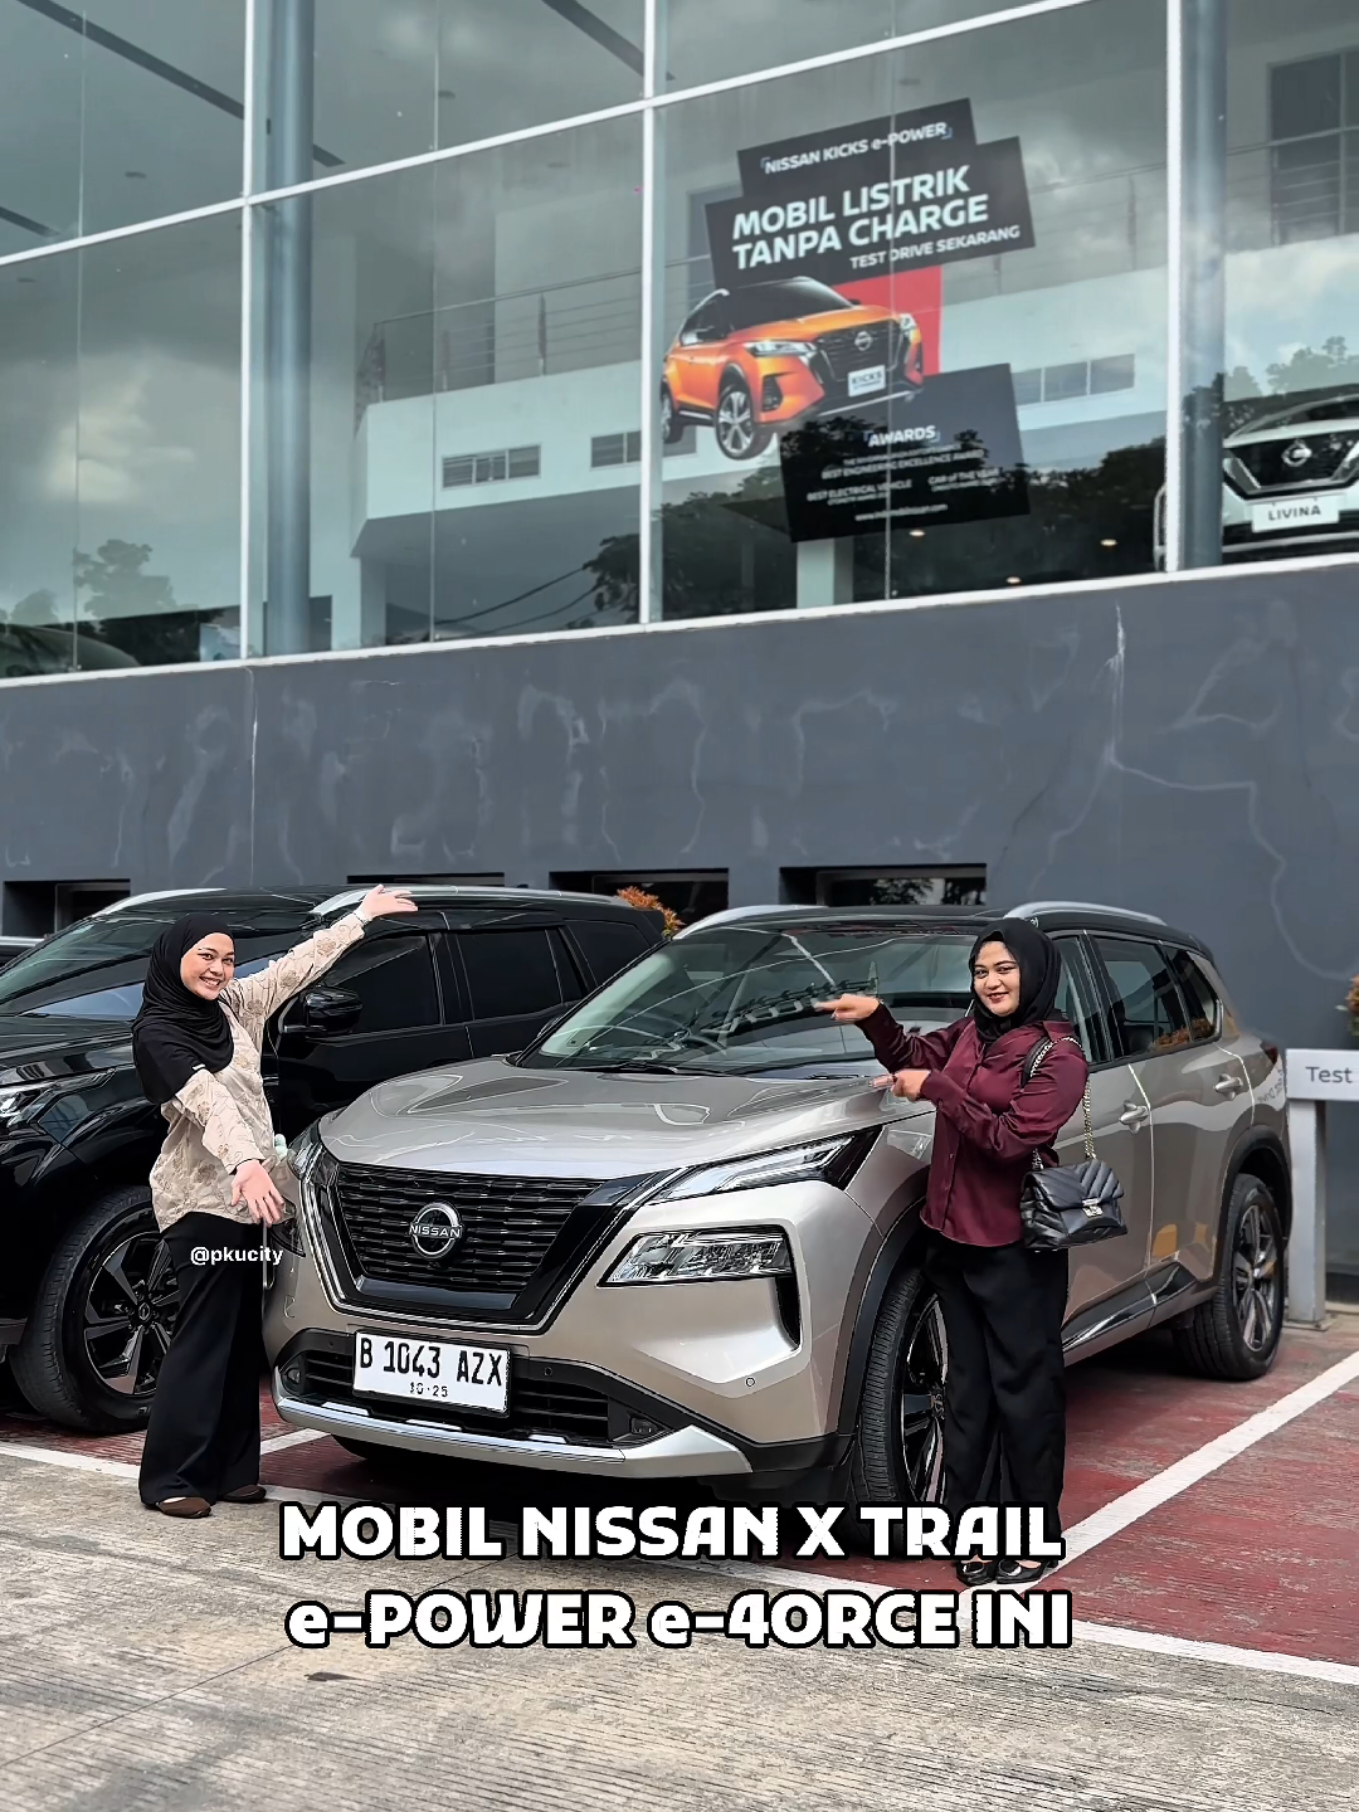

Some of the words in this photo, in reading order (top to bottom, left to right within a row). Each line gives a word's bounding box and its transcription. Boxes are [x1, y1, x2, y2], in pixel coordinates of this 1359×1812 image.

[764, 150, 821, 175] NISSAN
[823, 138, 869, 162] KICKS
[871, 121, 947, 150] e-POWER
[732, 195, 836, 240] MOBIL
[842, 165, 971, 217] LISTRIK
[731, 225, 843, 270] TANPA
[848, 194, 989, 246] CHARGE
[849, 250, 887, 269] TEST
[889, 242, 934, 262] DRIVE
[935, 224, 1021, 253] SEKARANG
[867, 424, 936, 447] AWARDS
[1267, 504, 1322, 522] LIVINA
[1304, 1065, 1354, 1085] Test
[409, 1222, 460, 1238] NISSAN
[360, 1337, 373, 1369] B
[383, 1340, 442, 1379] 1043
[456, 1349, 503, 1387] AZX
